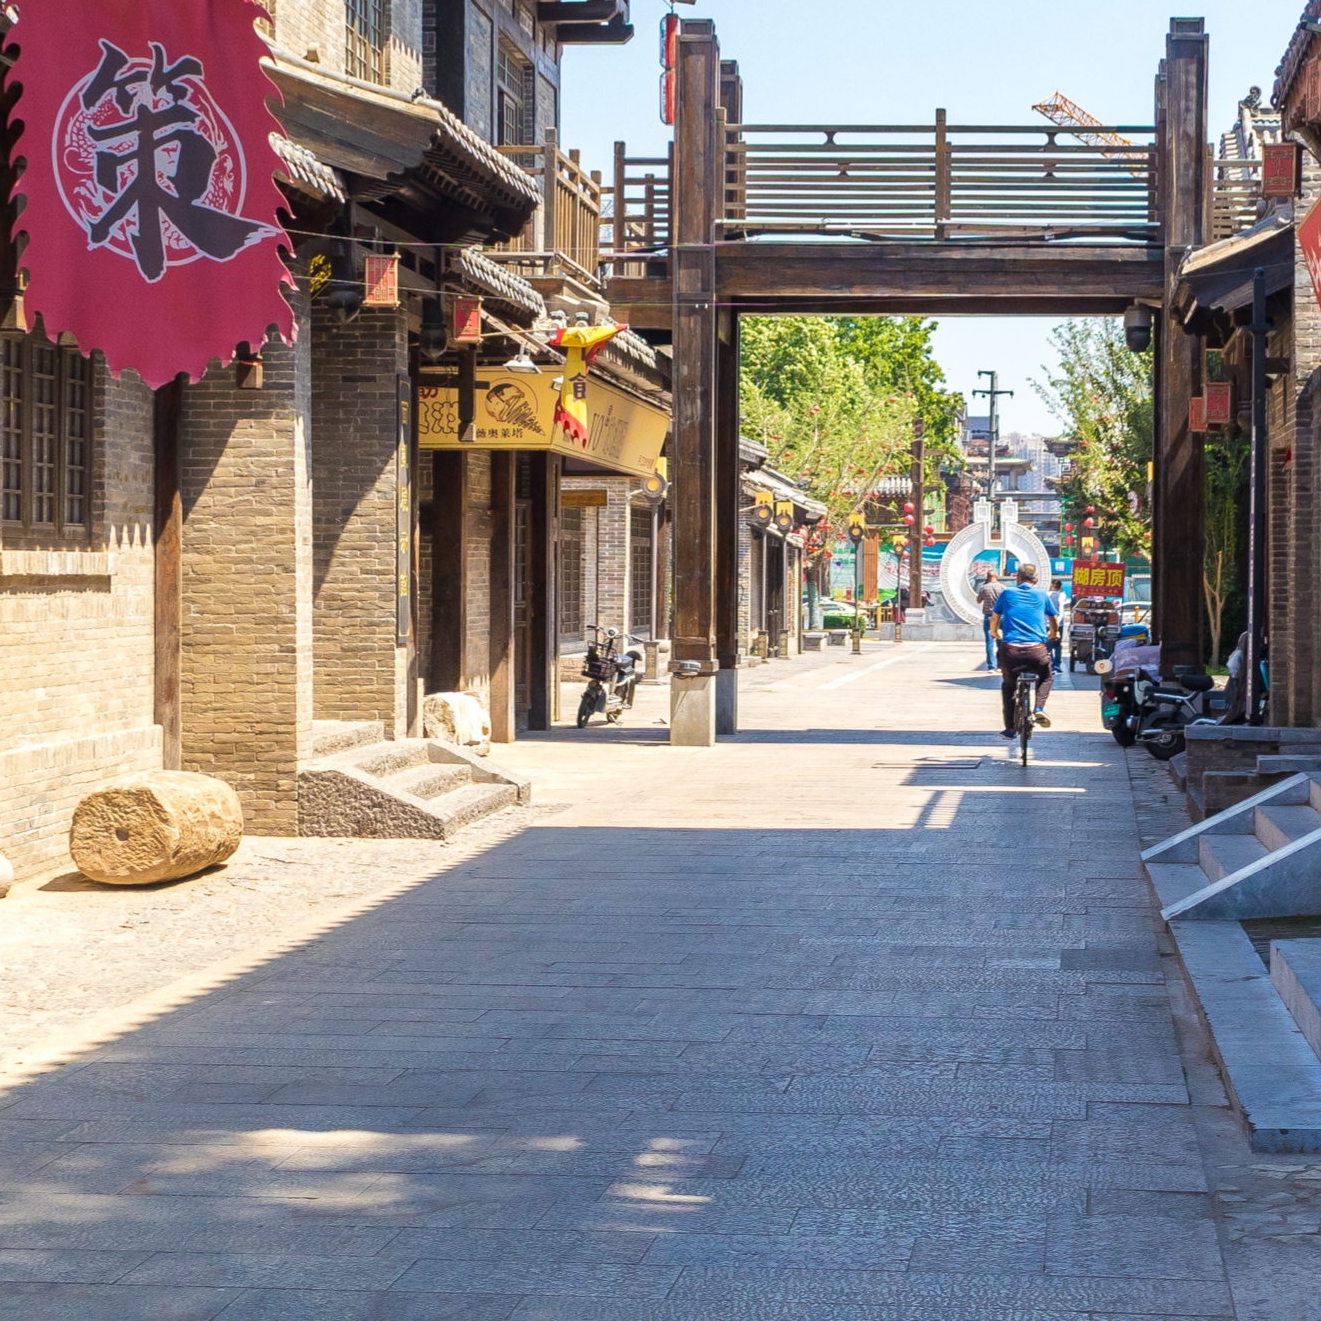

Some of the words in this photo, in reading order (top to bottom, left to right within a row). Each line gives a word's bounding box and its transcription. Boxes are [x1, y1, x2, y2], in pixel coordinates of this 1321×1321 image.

[81, 38, 283, 284] 策
[1073, 567, 1123, 587] 糊房顶
